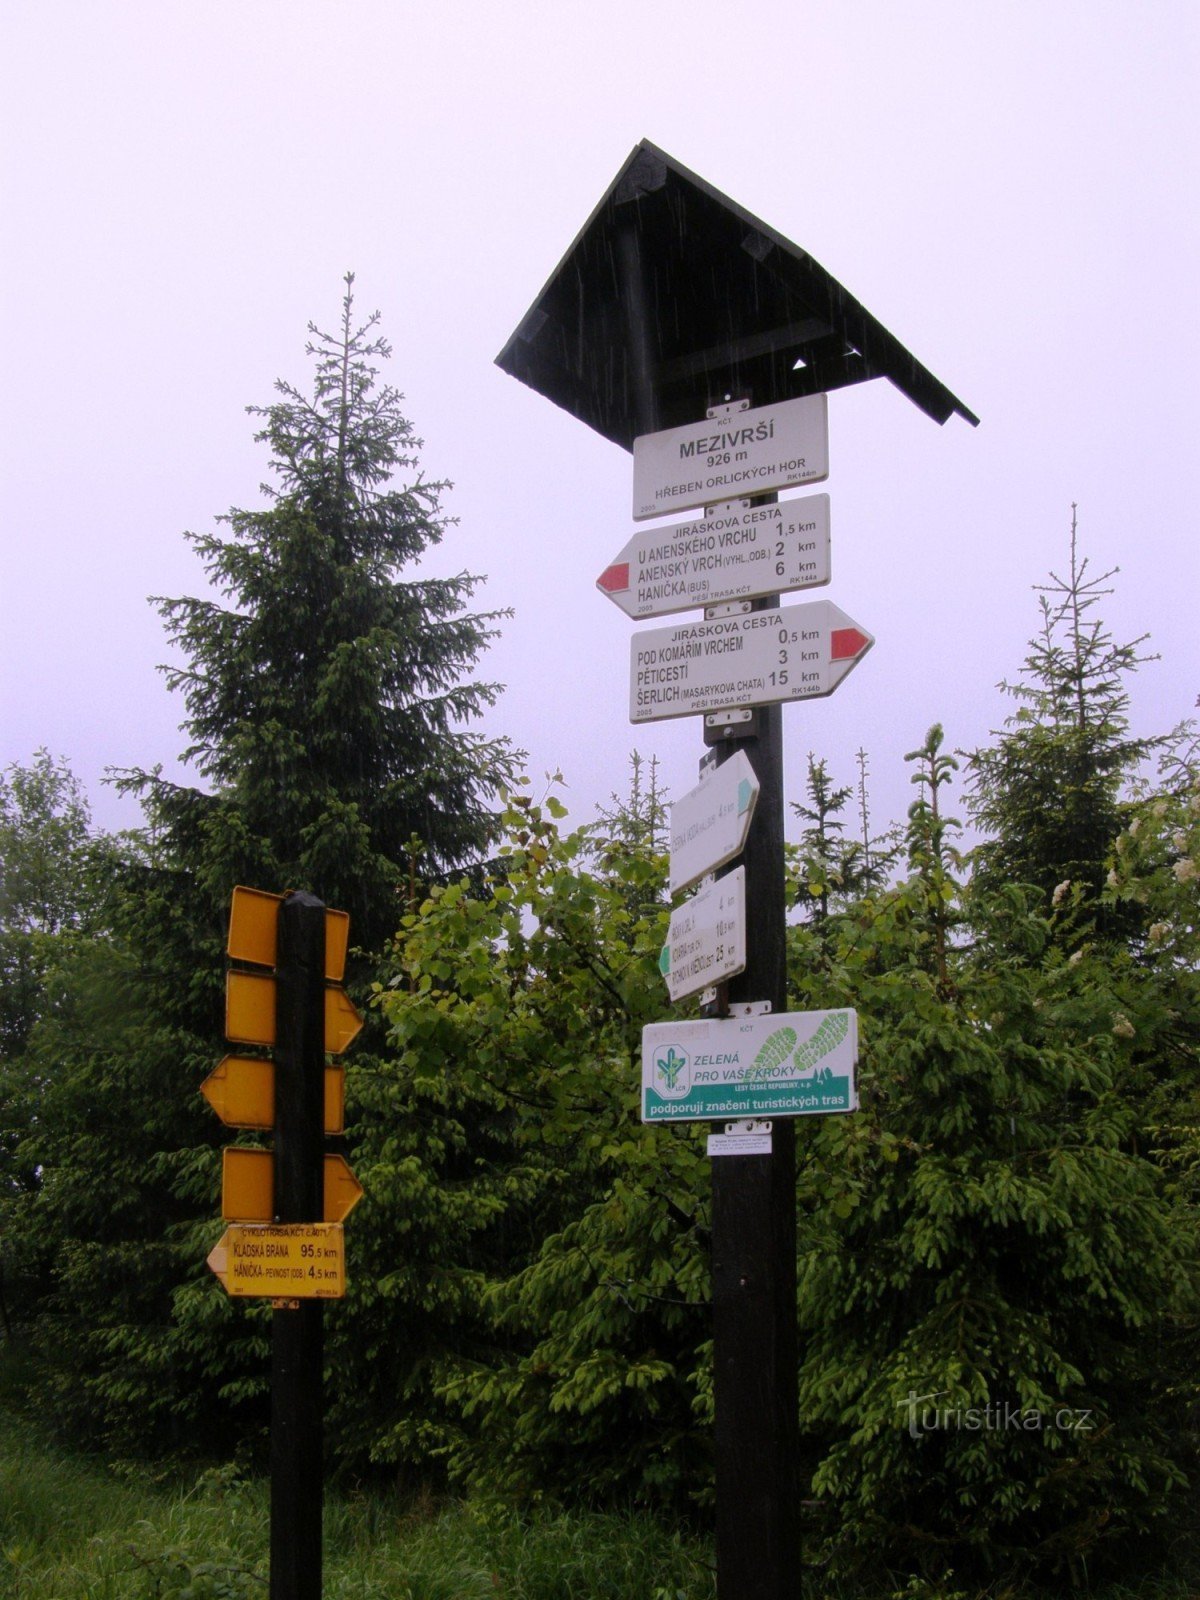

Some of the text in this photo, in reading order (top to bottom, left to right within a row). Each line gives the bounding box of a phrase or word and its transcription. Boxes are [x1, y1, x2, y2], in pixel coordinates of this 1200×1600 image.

[679, 420, 774, 459] MEZIVRŠÍ
[707, 451, 748, 468] 926 m
[655, 458, 806, 500] HŘEBEN ORLICKÝCH HOR
[673, 508, 782, 539] JIRÁSKOVA CESTA
[638, 522, 816, 564] U ANENSKÉHO VRCHU 1,5 km
[638, 560, 689, 584] ANENSKÝ
[692, 554, 722, 573] VRCH
[775, 542, 784, 556] 2
[798, 541, 816, 552] km
[638, 562, 816, 602] HANIČKA (BUS) 6 km
[710, 589, 734, 600] TRASA
[736, 584, 751, 595] KČT
[671, 615, 783, 642] JIRÁSKOVA CESTA
[638, 629, 819, 666] POD KOMÁŘÍM VRCHEM 0,5 km
[637, 649, 819, 686] PĚTICESTÍ 3 km
[637, 670, 820, 707] ŠERLICH (MASARYKOVA CHATA) 15 km
[792, 685, 820, 695] RK144b
[710, 696, 735, 708] TRASA
[736, 693, 752, 704] KČT
[740, 1024, 754, 1033] KČT
[694, 1051, 740, 1066] ZELENÁ
[694, 1066, 797, 1082] PRO VAŠE KROKY
[749, 1082, 766, 1091] ČESKÉ
[650, 1094, 844, 1116] podporují značení turistických tras
[234, 1242, 264, 1258] KLADSKÁ
[266, 1242, 289, 1258] BRÁNA
[325, 1248, 337, 1258] km
[308, 1266, 322, 1279] 4,5
[325, 1270, 337, 1279] km
